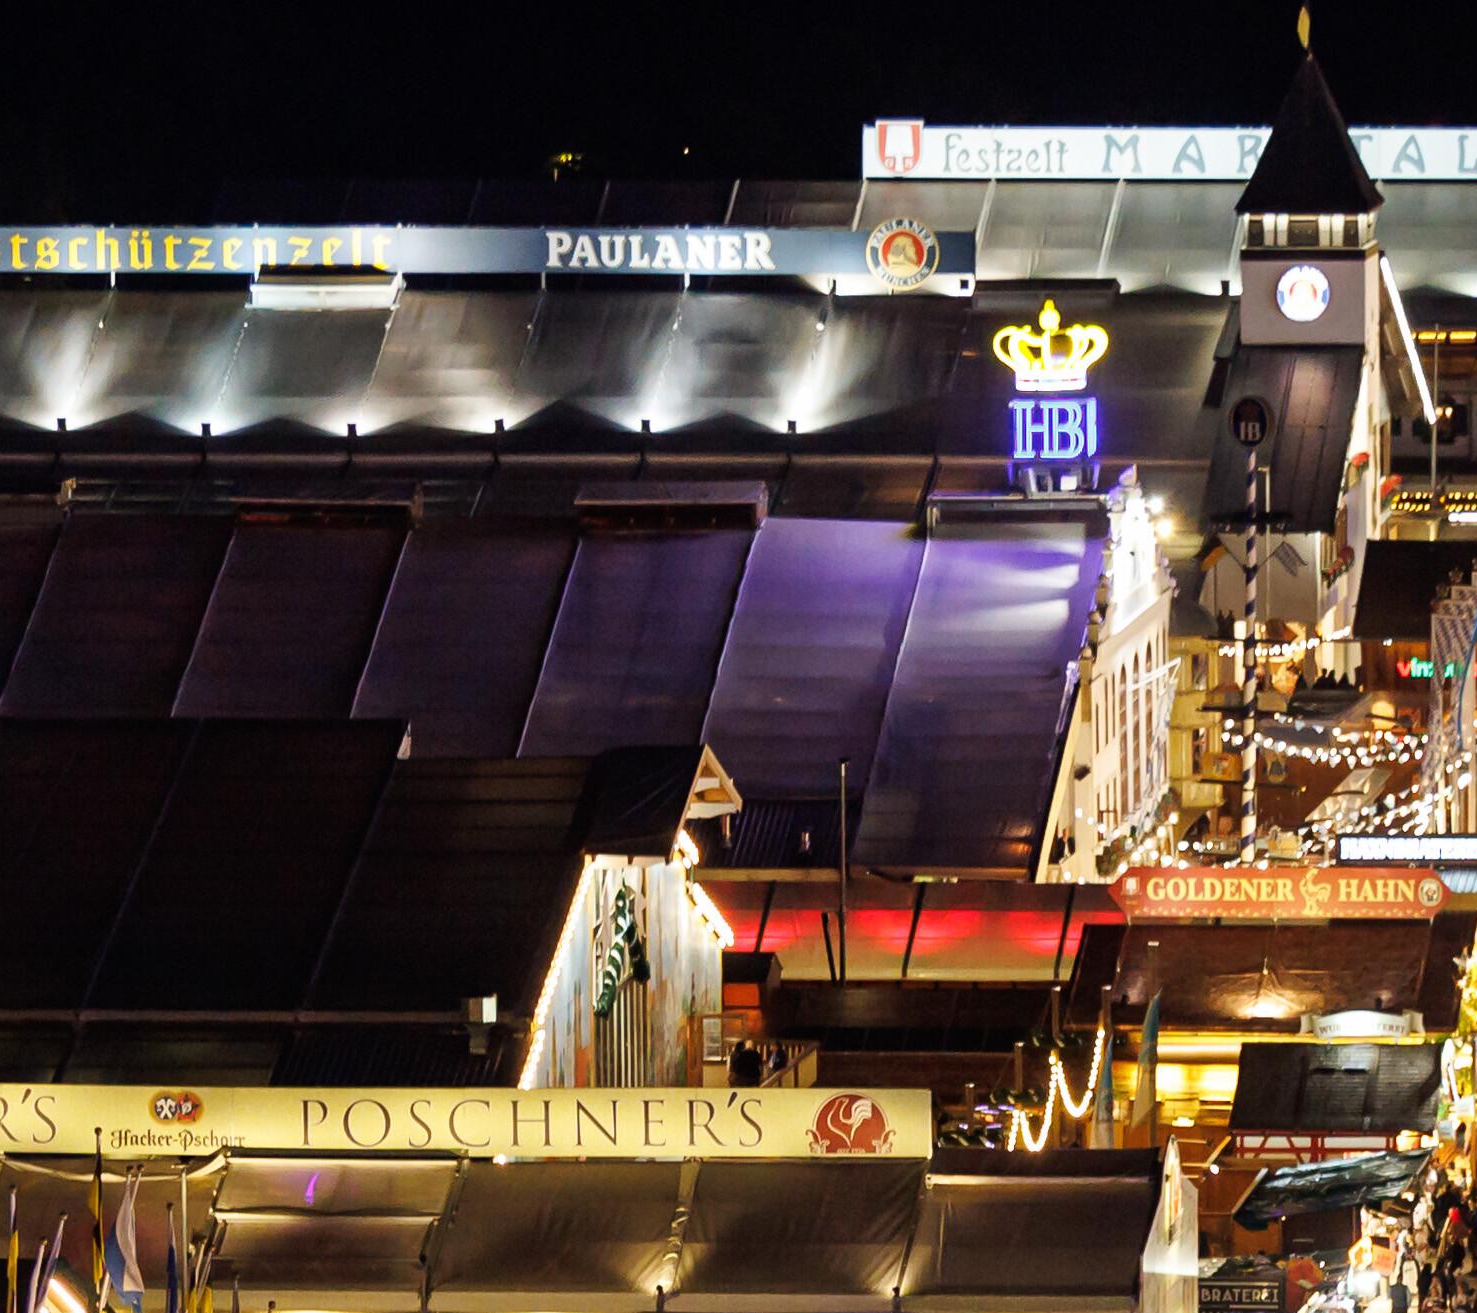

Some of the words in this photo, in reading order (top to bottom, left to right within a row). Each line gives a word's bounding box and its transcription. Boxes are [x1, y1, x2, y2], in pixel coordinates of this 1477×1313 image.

[943, 133, 1069, 175] Festzelt
[545, 230, 776, 272] PAULANER
[1147, 877, 1294, 903] GOLDENER
[1338, 877, 1415, 903] HAHN
[301, 1091, 765, 1151] POSCHNER'S
